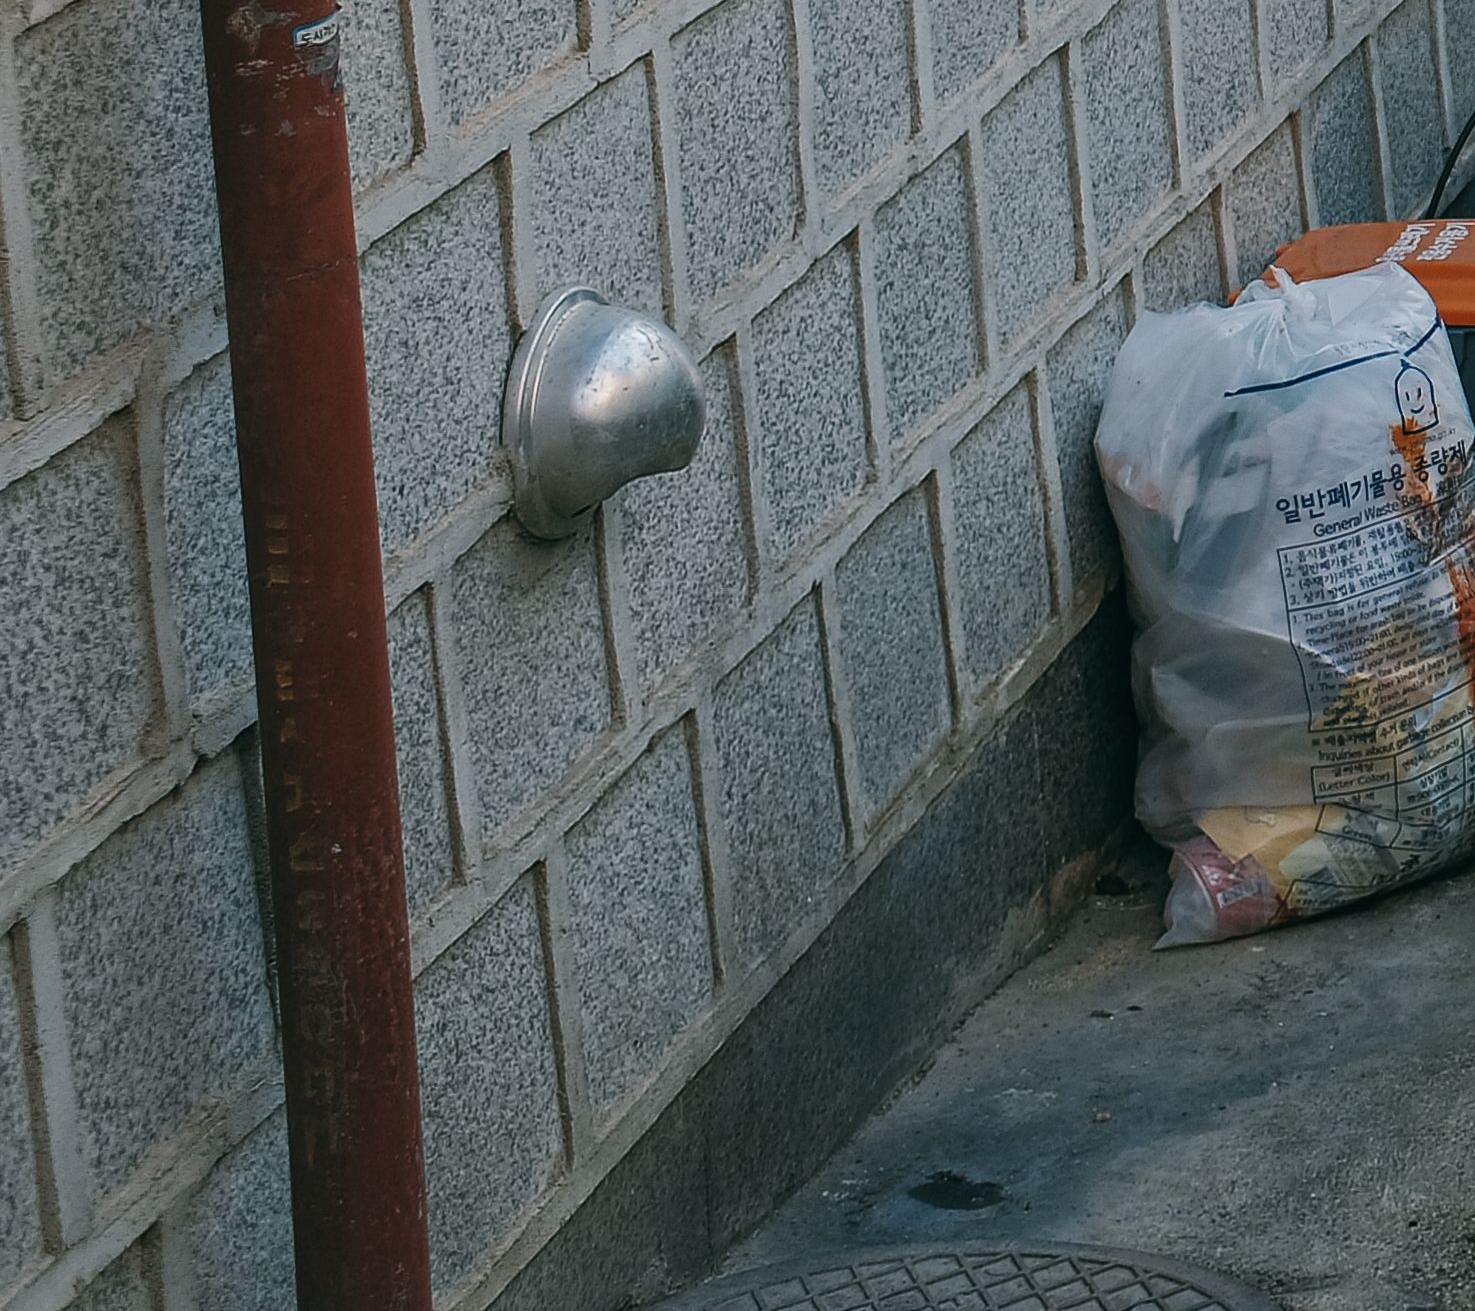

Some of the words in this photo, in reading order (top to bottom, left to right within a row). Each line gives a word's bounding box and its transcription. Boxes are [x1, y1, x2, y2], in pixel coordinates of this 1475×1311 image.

[1276, 464, 1406, 524] 일반폐기물용
[1414, 440, 1467, 483] 종량제
[1313, 514, 1363, 537] General
[1365, 503, 1399, 522] Waste
[1402, 494, 1423, 509] Bag
[1327, 607, 1346, 619] bag
[1359, 607, 1379, 620] food
